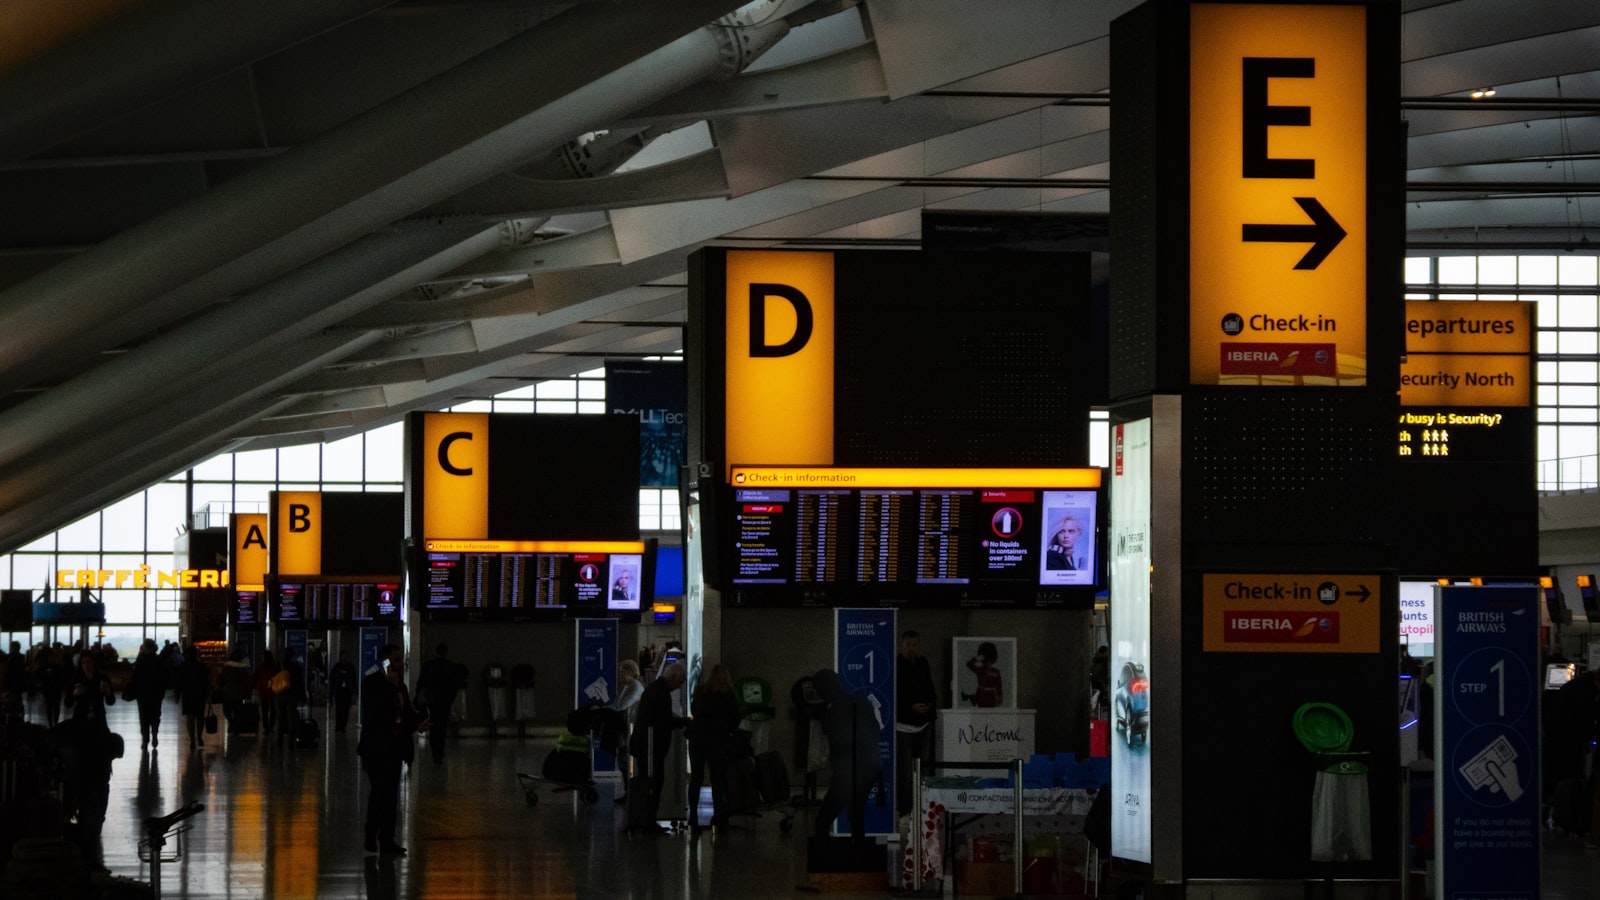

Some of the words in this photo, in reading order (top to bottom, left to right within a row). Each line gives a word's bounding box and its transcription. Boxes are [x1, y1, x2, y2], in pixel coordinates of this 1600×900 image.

[1242, 57, 1315, 179] E
[748, 283, 813, 358] D
[1249, 314, 1336, 331] Check-in
[1407, 317, 1515, 338] epartures
[1227, 351, 1279, 361] IBERIA
[1401, 371, 1460, 389] ecurity
[1465, 372, 1515, 386] North
[658, 409, 684, 424] Tec
[1406, 412, 1435, 427] busy
[1437, 413, 1447, 424] is
[1448, 413, 1502, 427] Security?
[437, 431, 473, 476] C
[748, 473, 793, 482] Check-in
[796, 473, 856, 482] information
[288, 503, 311, 533] B
[241, 524, 267, 550] A
[57, 563, 151, 588] CAFFÈ
[1224, 582, 1312, 599] Check-in
[1231, 618, 1293, 630] IBERIA
[1403, 612, 1428, 621] unts
[1458, 611, 1505, 622] BRITISH
[846, 622, 874, 630] BRITISH
[1400, 624, 1433, 636] utopil
[1456, 622, 1507, 633] AIRWAYS
[596, 647, 603, 670] 1
[847, 663, 864, 671] STEP
[864, 649, 874, 684] 1
[1459, 682, 1488, 694] STEP
[1489, 658, 1505, 718] 1
[958, 724, 1024, 745] Welcome
[1462, 818, 1478, 828] you
[1479, 817, 1490, 826] do
[1454, 828, 1473, 838] have
